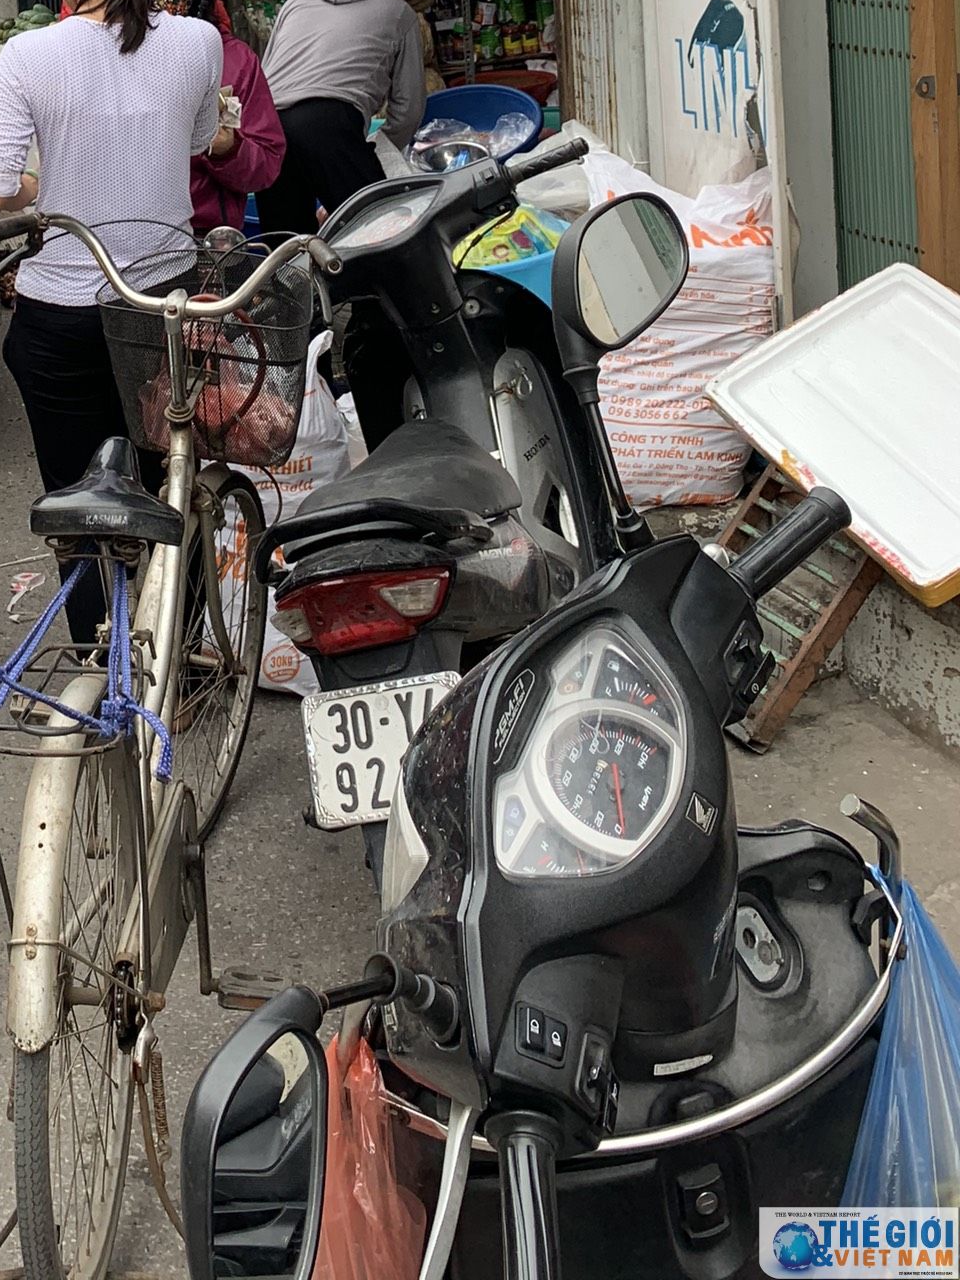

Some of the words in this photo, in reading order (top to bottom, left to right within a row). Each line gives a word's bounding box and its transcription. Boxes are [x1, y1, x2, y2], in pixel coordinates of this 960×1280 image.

[610, 430, 646, 444] CÔNG
[651, 435, 666, 445] TY
[671, 435, 704, 446] TNHH
[611, 446, 644, 458] PHÁT
[648, 445, 684, 459] TRIỂN
[688, 451, 714, 461] LAM
[336, 757, 391, 813] 92
